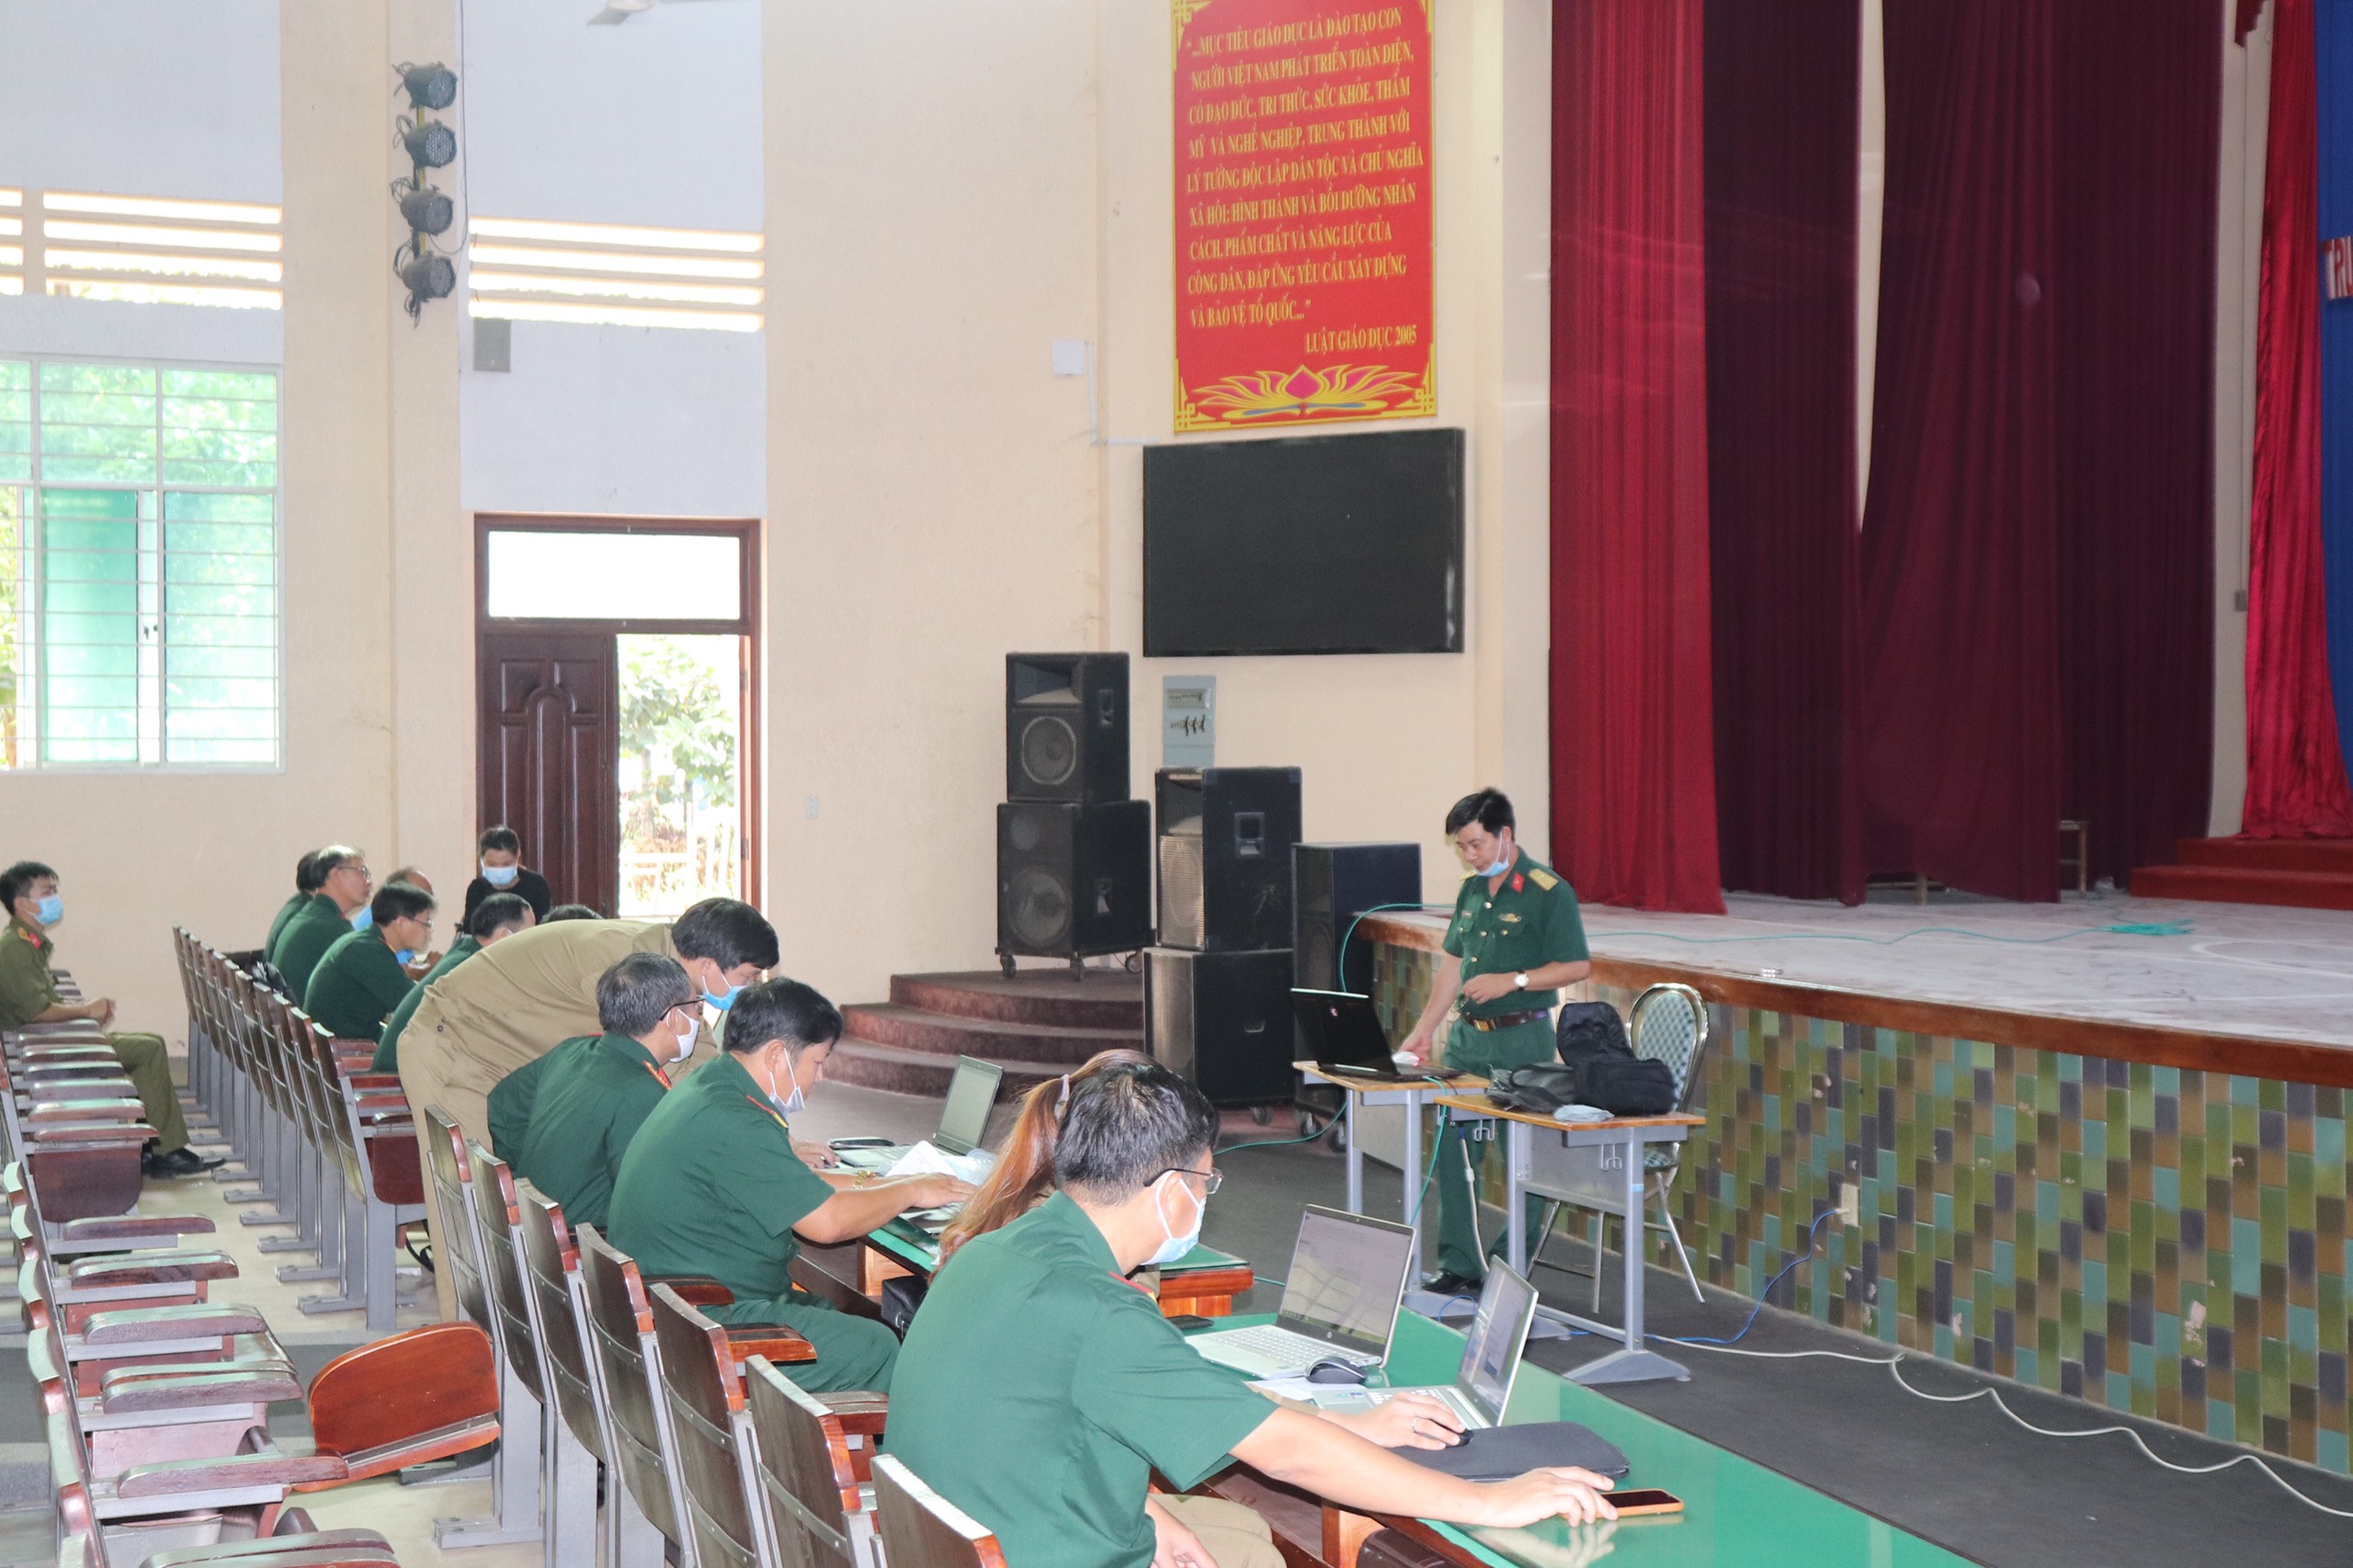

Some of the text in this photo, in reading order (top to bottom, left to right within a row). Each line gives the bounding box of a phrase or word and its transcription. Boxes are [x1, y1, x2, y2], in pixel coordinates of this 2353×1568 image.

[1226, 25, 1251, 51] TIÊU
[1254, 20, 1281, 48] GIÁO
[1283, 21, 1306, 46] DỤC
[1309, 13, 1324, 40] LÀ
[1326, 10, 1350, 37] ĐÀO
[1353, 11, 1377, 36] TẠO
[1379, 6, 1402, 28] CON
[1227, 59, 1252, 87] VIỆT
[1254, 60, 1279, 82] NAM
[1281, 51, 1311, 77] PHÁT
[1313, 40, 1347, 74] TRIỂN
[1349, 40, 1381, 69] TOÀN
[1189, 99, 1204, 124] CÓ
[1206, 101, 1230, 125] ĐẠO
[1231, 94, 1257, 119] ĐỨC,
[1259, 95, 1278, 116] TRI
[1279, 85, 1313, 113] THỨC,
[1314, 83, 1336, 108] SỨC
[1376, 67, 1410, 100] THẨM
[1211, 131, 1225, 156] VÀ
[1228, 121, 1257, 154] NGHỀ
[1307, 120, 1346, 144] TRUNG
[1348, 111, 1388, 140] THÀNH
[1390, 107, 1410, 133] VỚI
[1188, 166, 1199, 193] LÝ
[1243, 161, 1266, 189] ĐỘC
[1267, 158, 1289, 187] LẬP
[1291, 154, 1314, 181] DÂN
[1317, 152, 1340, 181] TỘC
[1342, 149, 1357, 175] VÀ
[1360, 142, 1384, 173] CHỦ
[1387, 141, 1424, 169] NGHĨA
[1233, 196, 1259, 222] HÌNH
[1261, 192, 1299, 220] THÀNH
[1302, 188, 1316, 214] VÀ
[1319, 182, 1338, 212] BỒI
[1383, 177, 1415, 205] NHÂN
[1225, 226, 1257, 257] PHẨM
[1259, 223, 1289, 254] CHẤT
[1291, 223, 1306, 250] VÀ
[1310, 223, 1340, 248] NĂNG
[1343, 220, 1366, 248] LỰC
[1369, 213, 1392, 242] CỦA
[1188, 251, 1407, 294] CÔNG DÂN, ĐÁP ỨNG YÊU CẦU XÂY DỰNG
[1191, 302, 1205, 327] VÀ
[1208, 300, 1230, 326] BẢO
[1233, 299, 1246, 328] VỆ
[1249, 292, 1264, 324] TỔ
[1306, 324, 1417, 355] LUẬT GIÁO DỤC 2005
